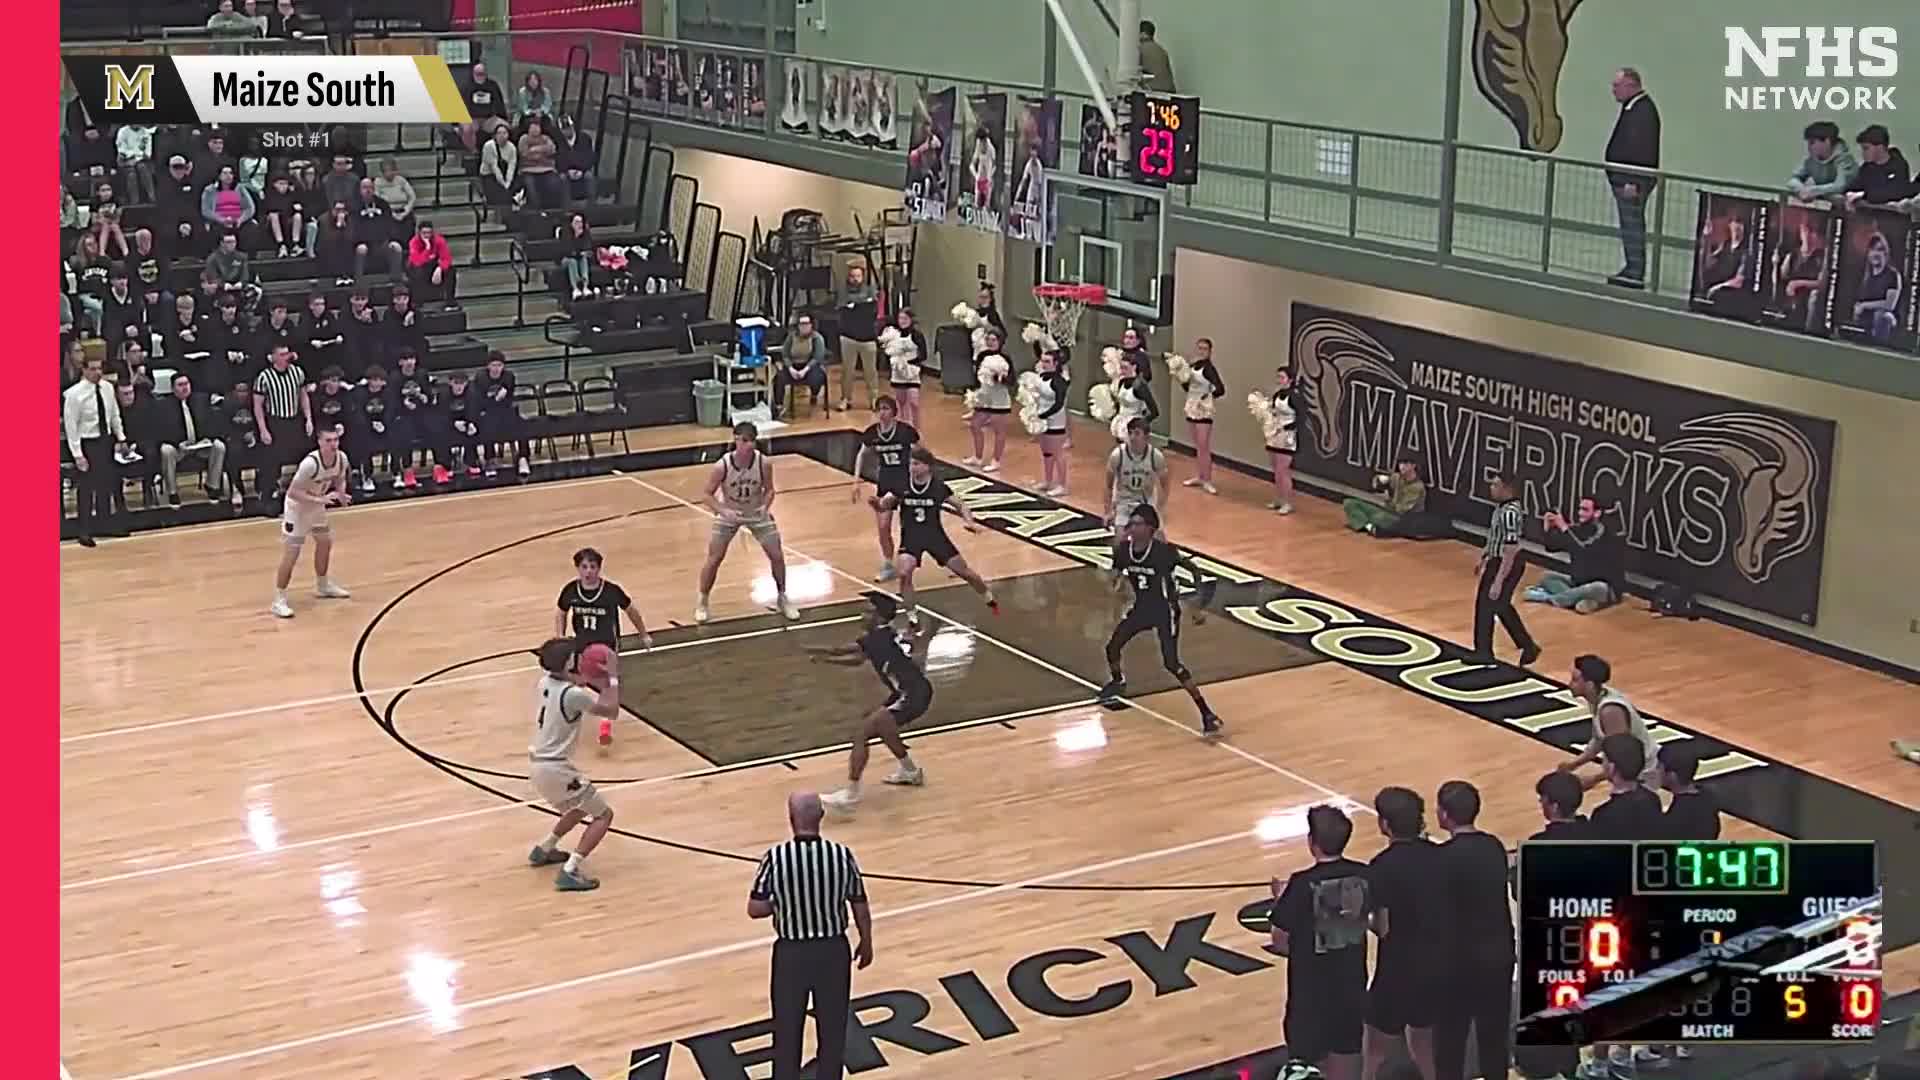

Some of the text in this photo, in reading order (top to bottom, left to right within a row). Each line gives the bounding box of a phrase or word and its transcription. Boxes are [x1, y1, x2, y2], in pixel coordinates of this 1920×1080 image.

[1146, 101, 1180, 130] 7:46
[1140, 127, 1174, 177] 23
[1411, 361, 1657, 444] MAIZE SOUTH HIGH SCHOOL
[1347, 380, 1731, 566] MAVERICKS
[914, 507, 926, 522] 3
[1137, 575, 1149, 590] 2
[1677, 846, 1779, 887] 7:47
[1549, 897, 1614, 919] HOME
[1683, 908, 1737, 923] PERIOD
[1588, 921, 1622, 968] 0
[1538, 969, 1587, 984] FOULS
[1783, 984, 1807, 1019] 5
[1850, 983, 1874, 1019] 0
[1681, 1024, 1734, 1038] MATCH
[1831, 1023, 1874, 1038] SCOR
